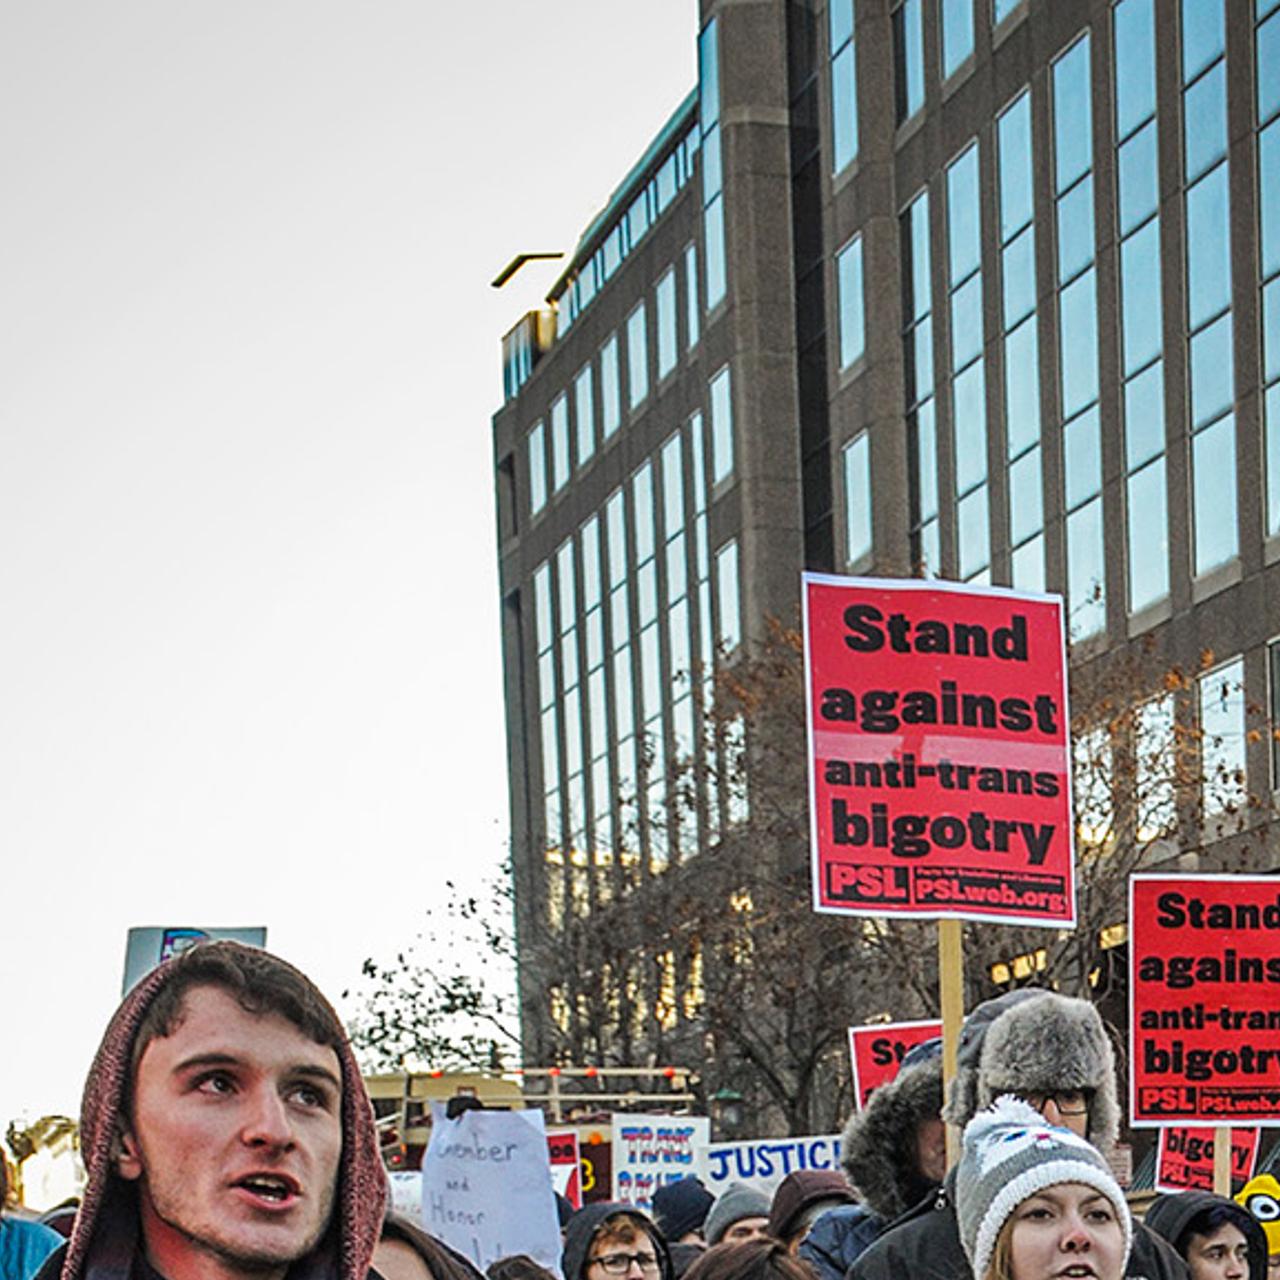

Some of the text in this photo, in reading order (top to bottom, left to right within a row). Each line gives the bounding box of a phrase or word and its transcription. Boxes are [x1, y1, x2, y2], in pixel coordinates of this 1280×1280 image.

[843, 603, 1028, 662] Stand
[820, 680, 1058, 734] against
[824, 753, 1060, 798] anti-trans
[831, 798, 1056, 866] bigotry
[830, 864, 906, 898] PSL
[917, 879, 1066, 912] PSLweb.org
[1142, 1088, 1195, 1111] PSL
[1167, 1128, 1250, 1170] bigoy
